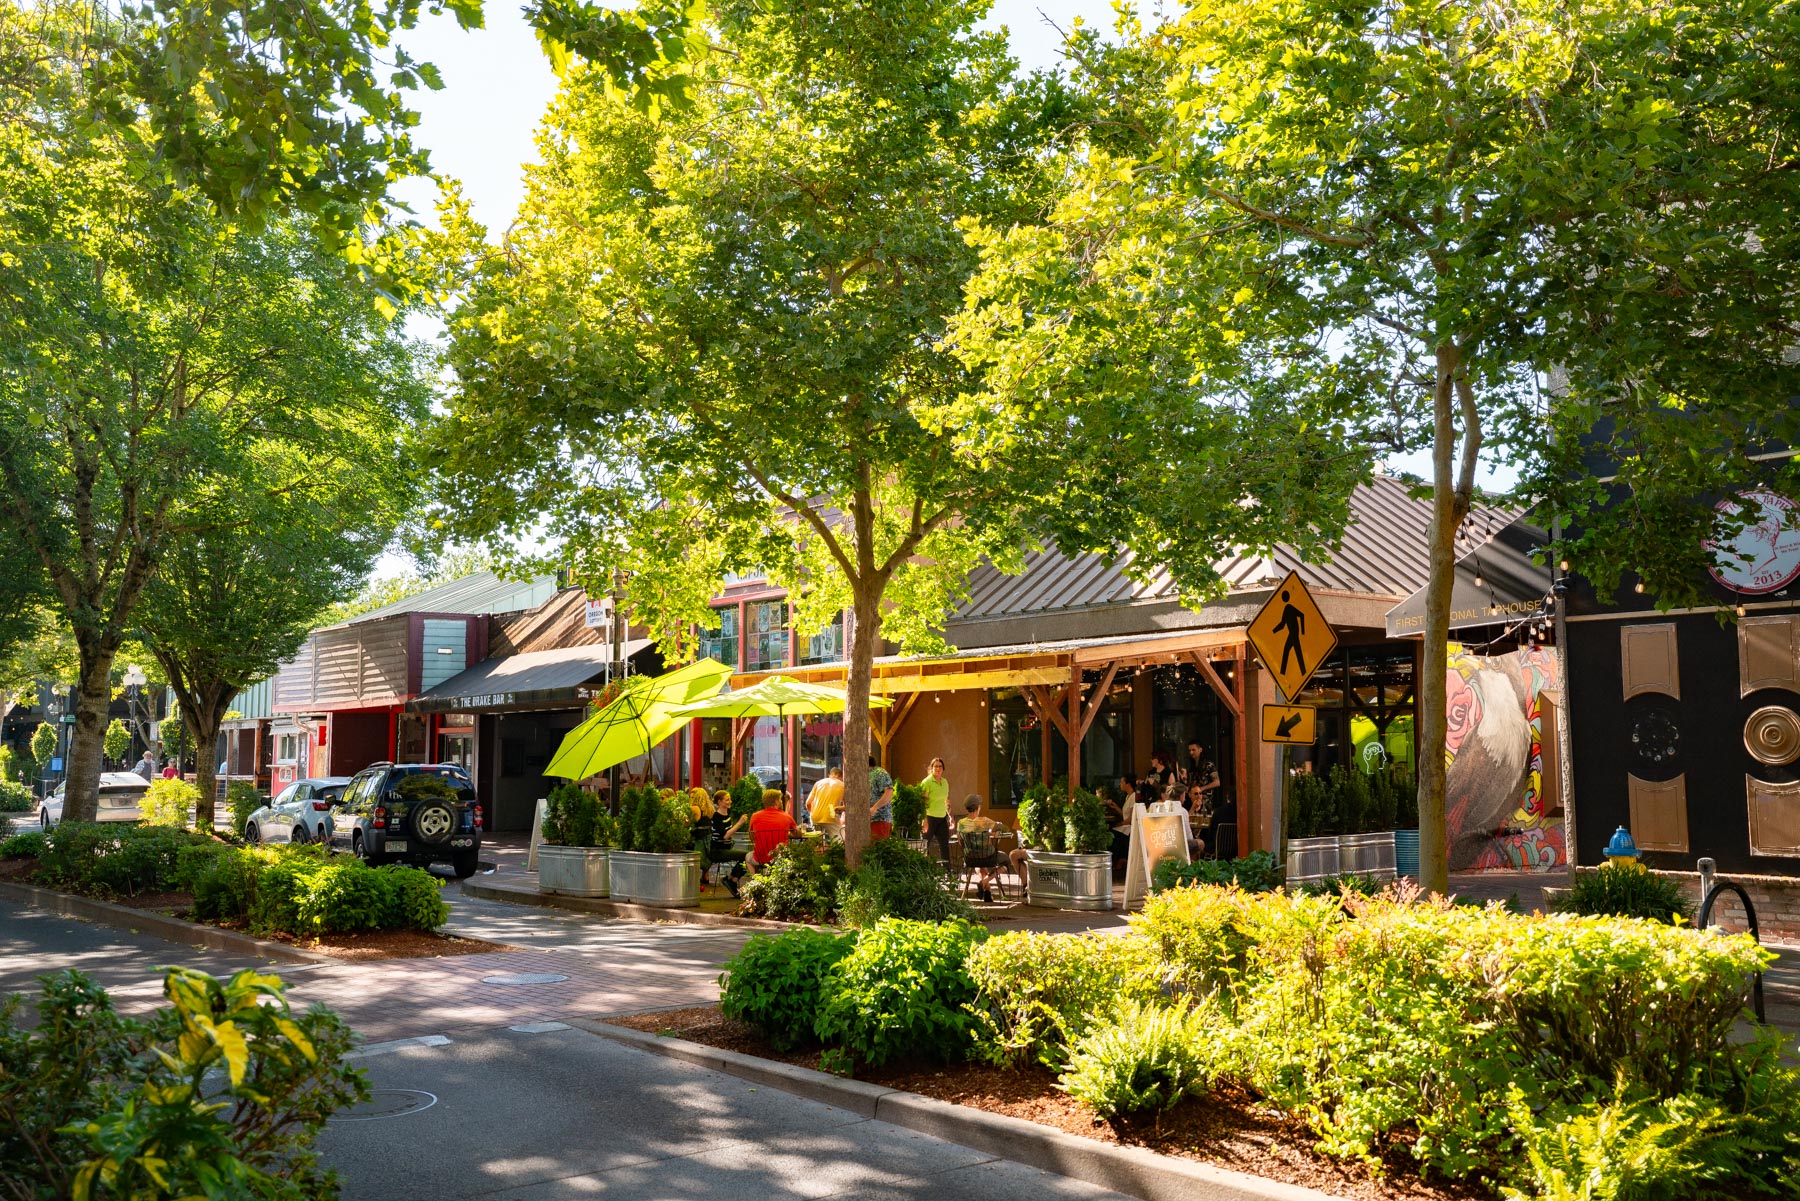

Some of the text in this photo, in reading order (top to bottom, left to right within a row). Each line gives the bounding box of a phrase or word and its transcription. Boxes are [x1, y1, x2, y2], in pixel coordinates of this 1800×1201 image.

[1753, 570, 1782, 585] 2013
[1395, 600, 1542, 629] FIRST ONAL TAPHOUSE
[460, 693, 505, 708] THE DRAKE BAR
[1151, 827, 1177, 846] Party
